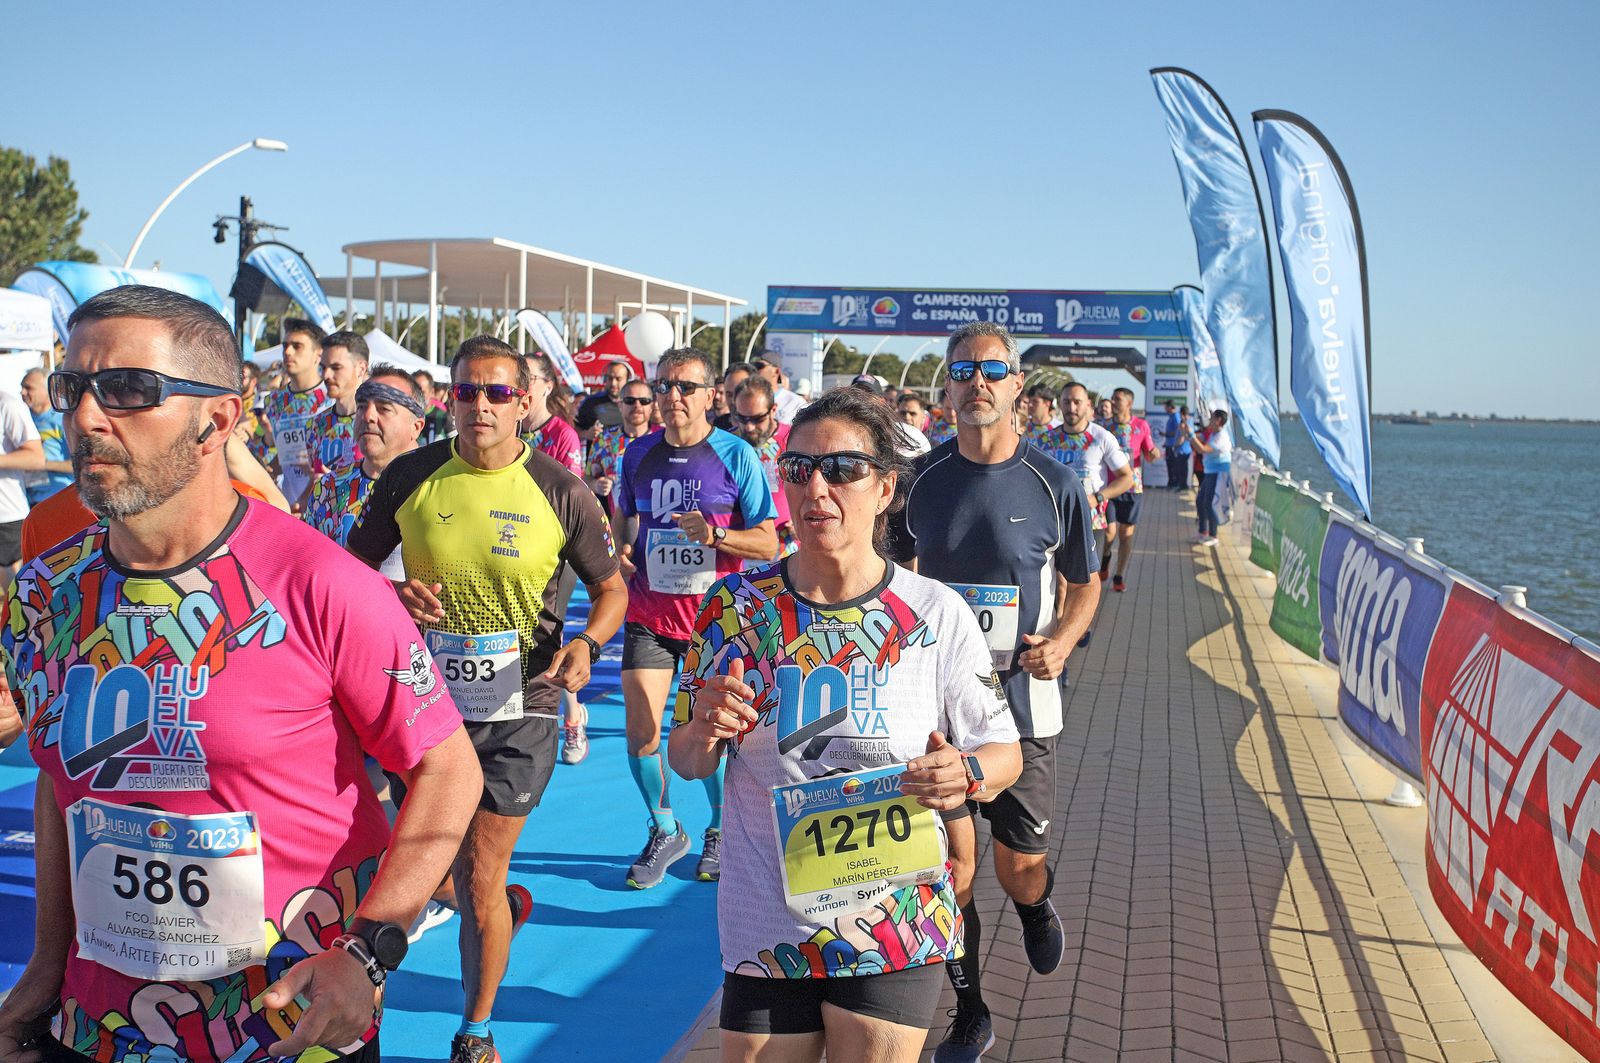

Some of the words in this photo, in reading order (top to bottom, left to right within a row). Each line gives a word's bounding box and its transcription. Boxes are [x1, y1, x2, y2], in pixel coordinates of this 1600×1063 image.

[913, 293, 1010, 307] CAMPEONATO
[912, 308, 928, 320] de
[930, 307, 979, 321] ESPAÑA
[986, 307, 1009, 323] 10
[1014, 307, 1043, 324] km
[1080, 306, 1120, 319] HUELVA
[1154, 308, 1183, 321] WiH
[683, 479, 701, 490] HU
[683, 489, 700, 501] EL
[489, 510, 530, 524] PATAPALOS
[491, 546, 520, 558] HUELVA
[658, 547, 704, 565] 1163
[984, 591, 1010, 603] 2023
[973, 609, 993, 632] 0
[484, 638, 510, 651] 2023
[445, 658, 496, 682] 593
[851, 665, 889, 687] HU
[155, 666, 207, 697] HU
[851, 687, 888, 711] EL
[153, 697, 206, 728] EL
[851, 711, 890, 735] VA
[152, 727, 204, 758] VA
[850, 741, 877, 752] PUERTA
[877, 741, 890, 752] DEL
[829, 750, 892, 762] DESCUBRIMIENTO
[152, 763, 187, 775] PUERTA
[188, 764, 206, 776] DEL
[128, 776, 208, 788] DESCUBRIMIENTO
[872, 774, 902, 796] 202
[804, 787, 839, 804] HUELVA
[845, 795, 865, 804] WiHu
[104, 816, 143, 837] HUELVA
[805, 804, 911, 857] 1270
[150, 841, 174, 850] WiHu
[186, 827, 240, 850] 2023
[846, 857, 881, 870] ISABEL
[112, 853, 210, 908] 586
[832, 871, 865, 886] MARÍN
[866, 866, 899, 882] PÉREZ
[804, 899, 849, 915] HYUNDAI
[107, 921, 155, 940] ALVAREZ
[158, 931, 220, 944] SANCHEZ
